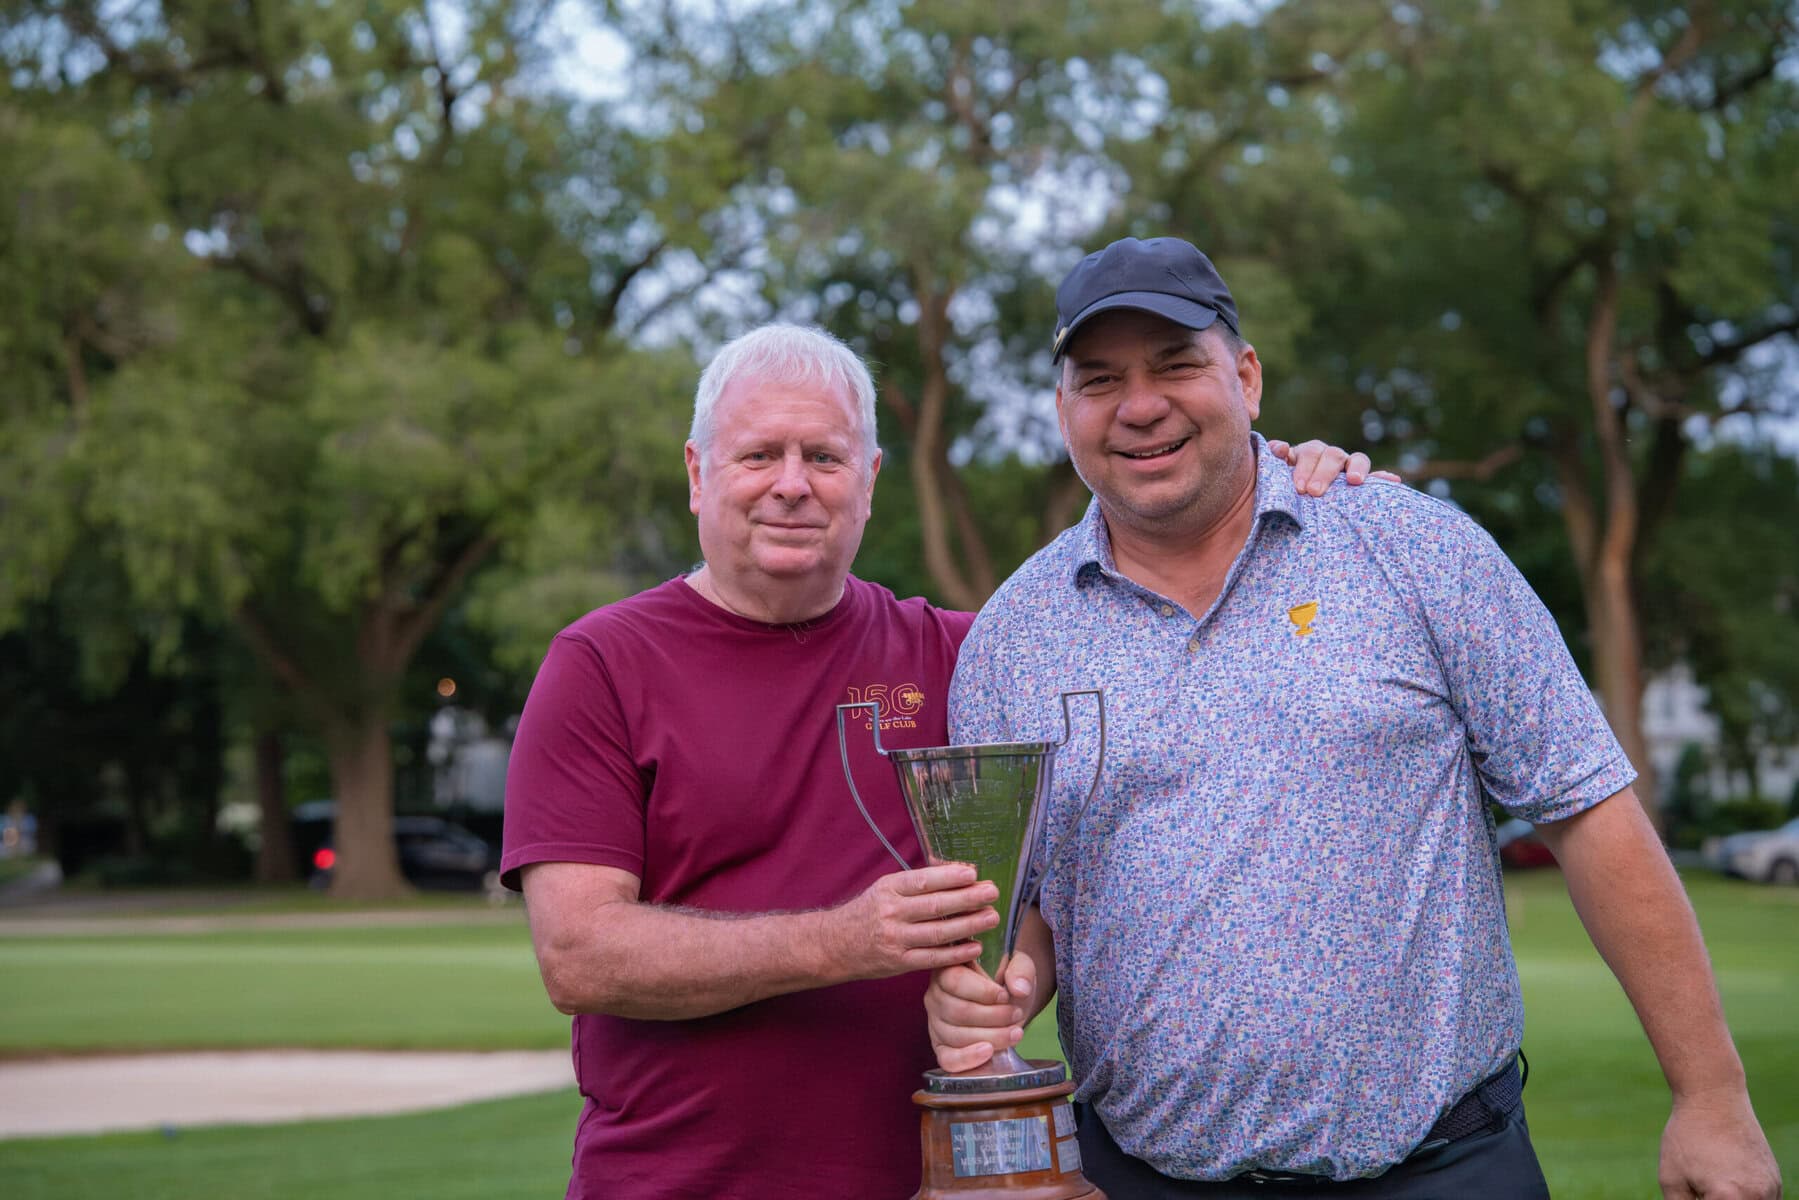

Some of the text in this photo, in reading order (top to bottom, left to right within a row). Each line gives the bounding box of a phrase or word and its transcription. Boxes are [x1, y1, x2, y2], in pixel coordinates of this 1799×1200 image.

[847, 683, 920, 719] 150
[865, 720, 917, 730] GLF CLUB
